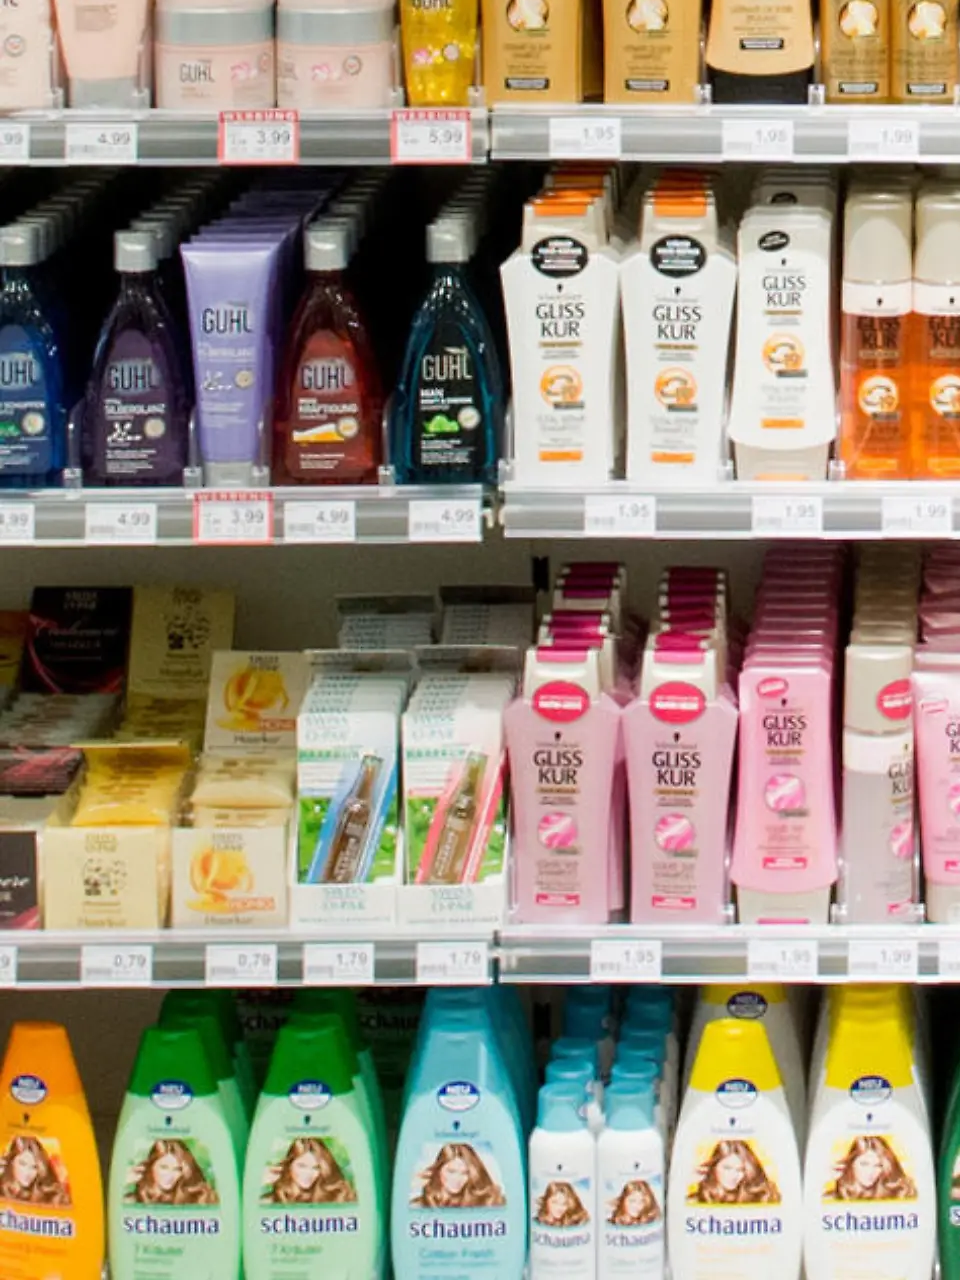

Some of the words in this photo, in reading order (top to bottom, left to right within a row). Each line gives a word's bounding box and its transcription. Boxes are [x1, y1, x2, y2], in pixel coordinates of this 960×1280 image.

[762, 276, 806, 291] GLISS
[767, 292, 801, 306] KUR
[536, 303, 585, 319] GLISS
[653, 305, 701, 321] GLISS
[202, 308, 253, 333] GUHL
[541, 322, 580, 339] KUR
[658, 323, 696, 340] KUR
[0, 359, 36, 387] UHL
[422, 355, 472, 380] GUHL
[107, 366, 158, 390] GUHL
[302, 366, 350, 389] GUHL
[762, 715, 806, 730] GLISS
[767, 731, 802, 746] KUR
[534, 751, 583, 767] GLISS
[652, 752, 701, 769] GLISS
[538, 769, 577, 785] KUR
[657, 770, 696, 786] KUR
[123, 1214, 220, 1235] schauma
[261, 1214, 358, 1234] schauma
[409, 1219, 507, 1238] schauma
[685, 1216, 782, 1235] schauma
[822, 1211, 919, 1231] schauma
